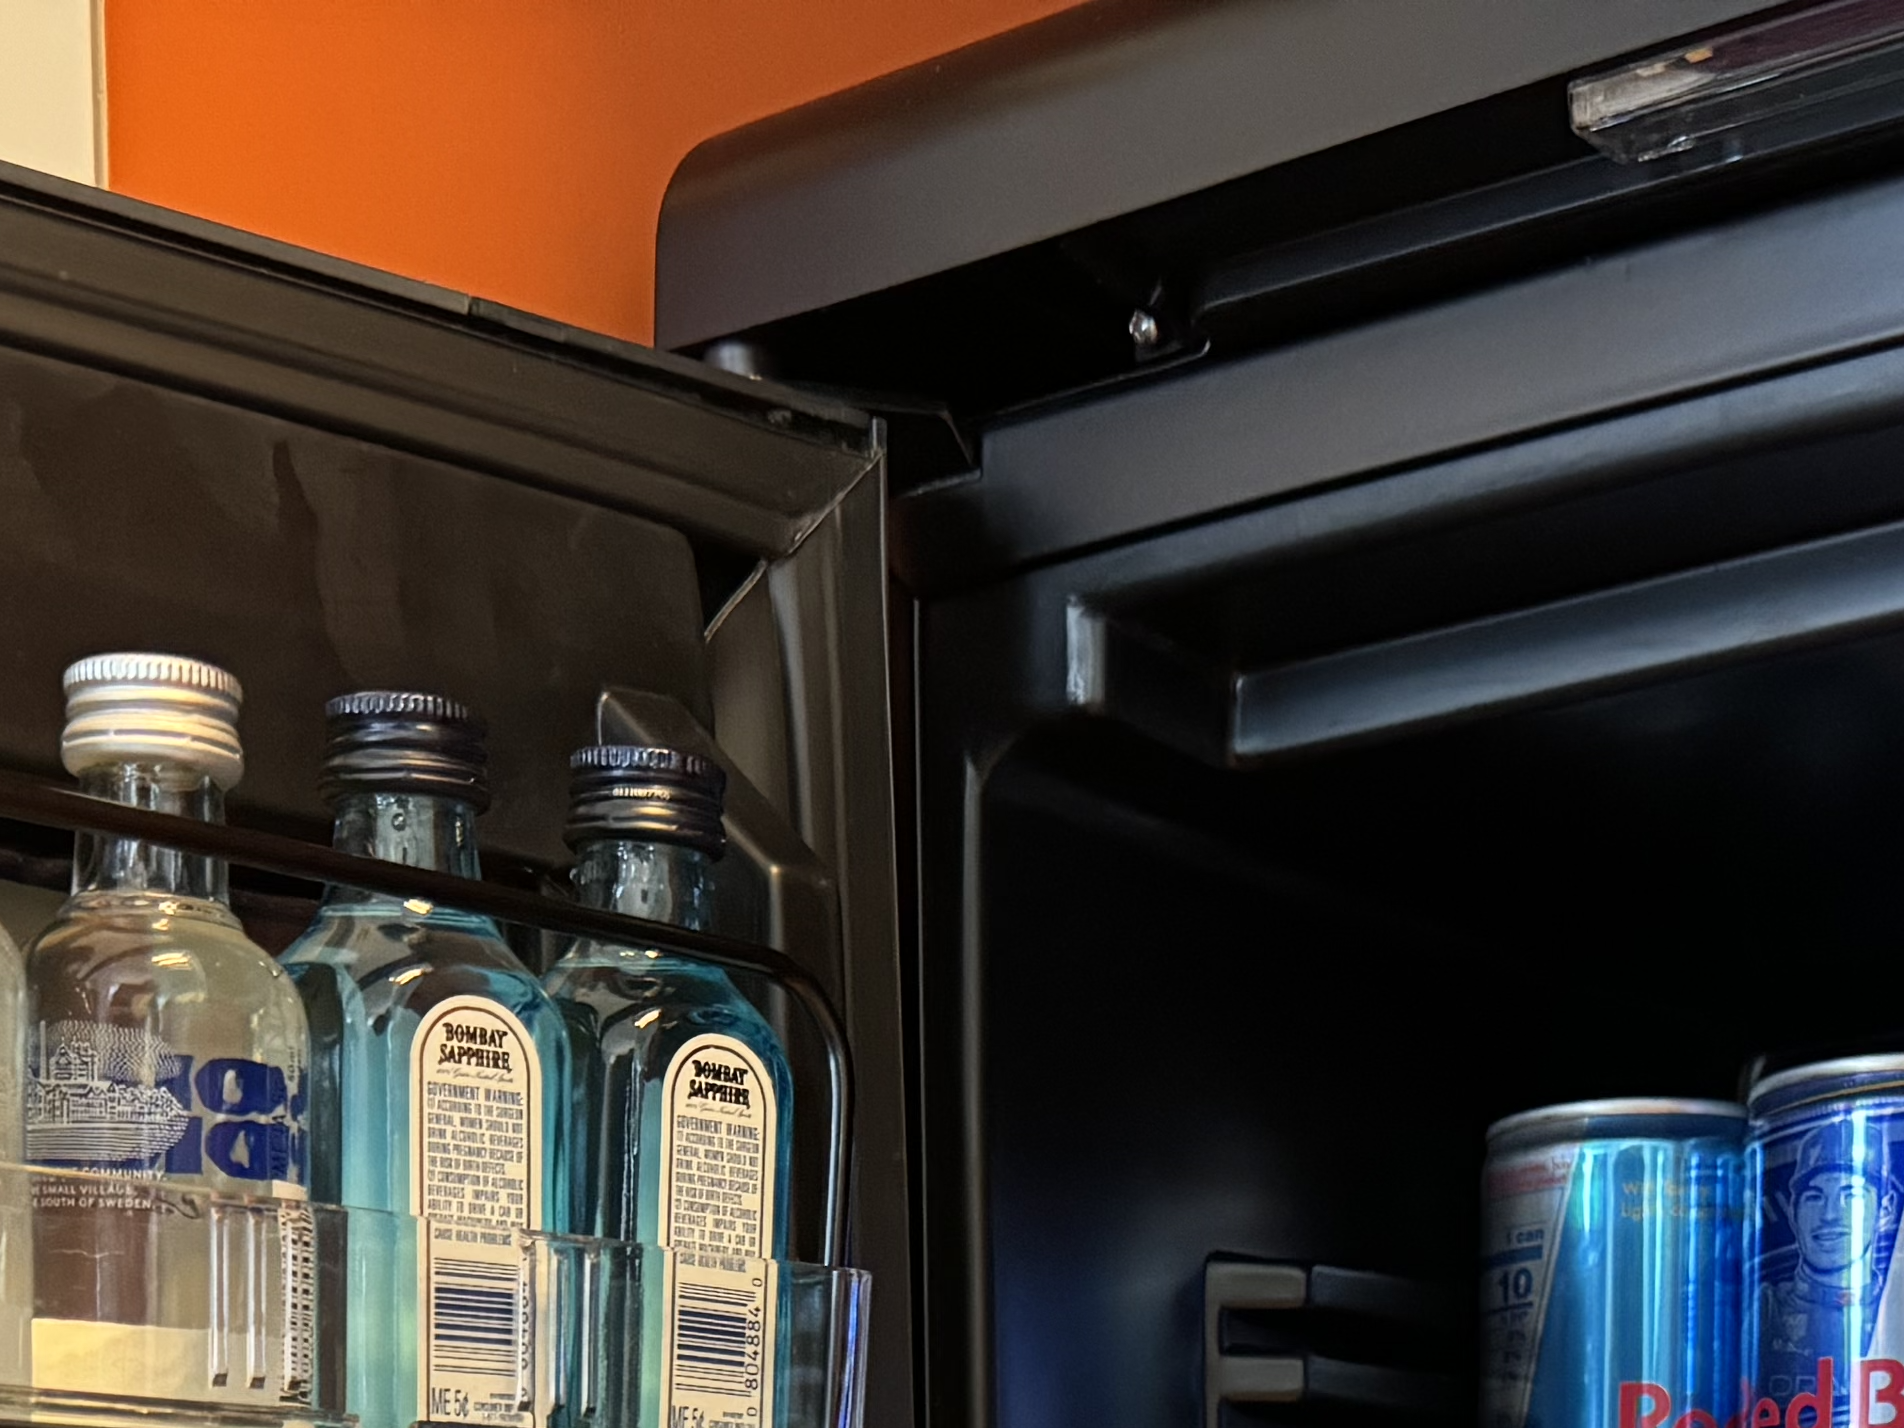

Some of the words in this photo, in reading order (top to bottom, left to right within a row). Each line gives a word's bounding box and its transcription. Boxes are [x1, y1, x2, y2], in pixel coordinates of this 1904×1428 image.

[442, 1022, 508, 1048] BOMBAY
[438, 1044, 512, 1073] SAPPHIRE
[691, 1059, 748, 1086] BOMBAY
[687, 1079, 750, 1109] SAPPHIRE
[1497, 1267, 1533, 1303] 10
[431, 1388, 451, 1416] ME
[454, 1389, 469, 1418] 5¢
